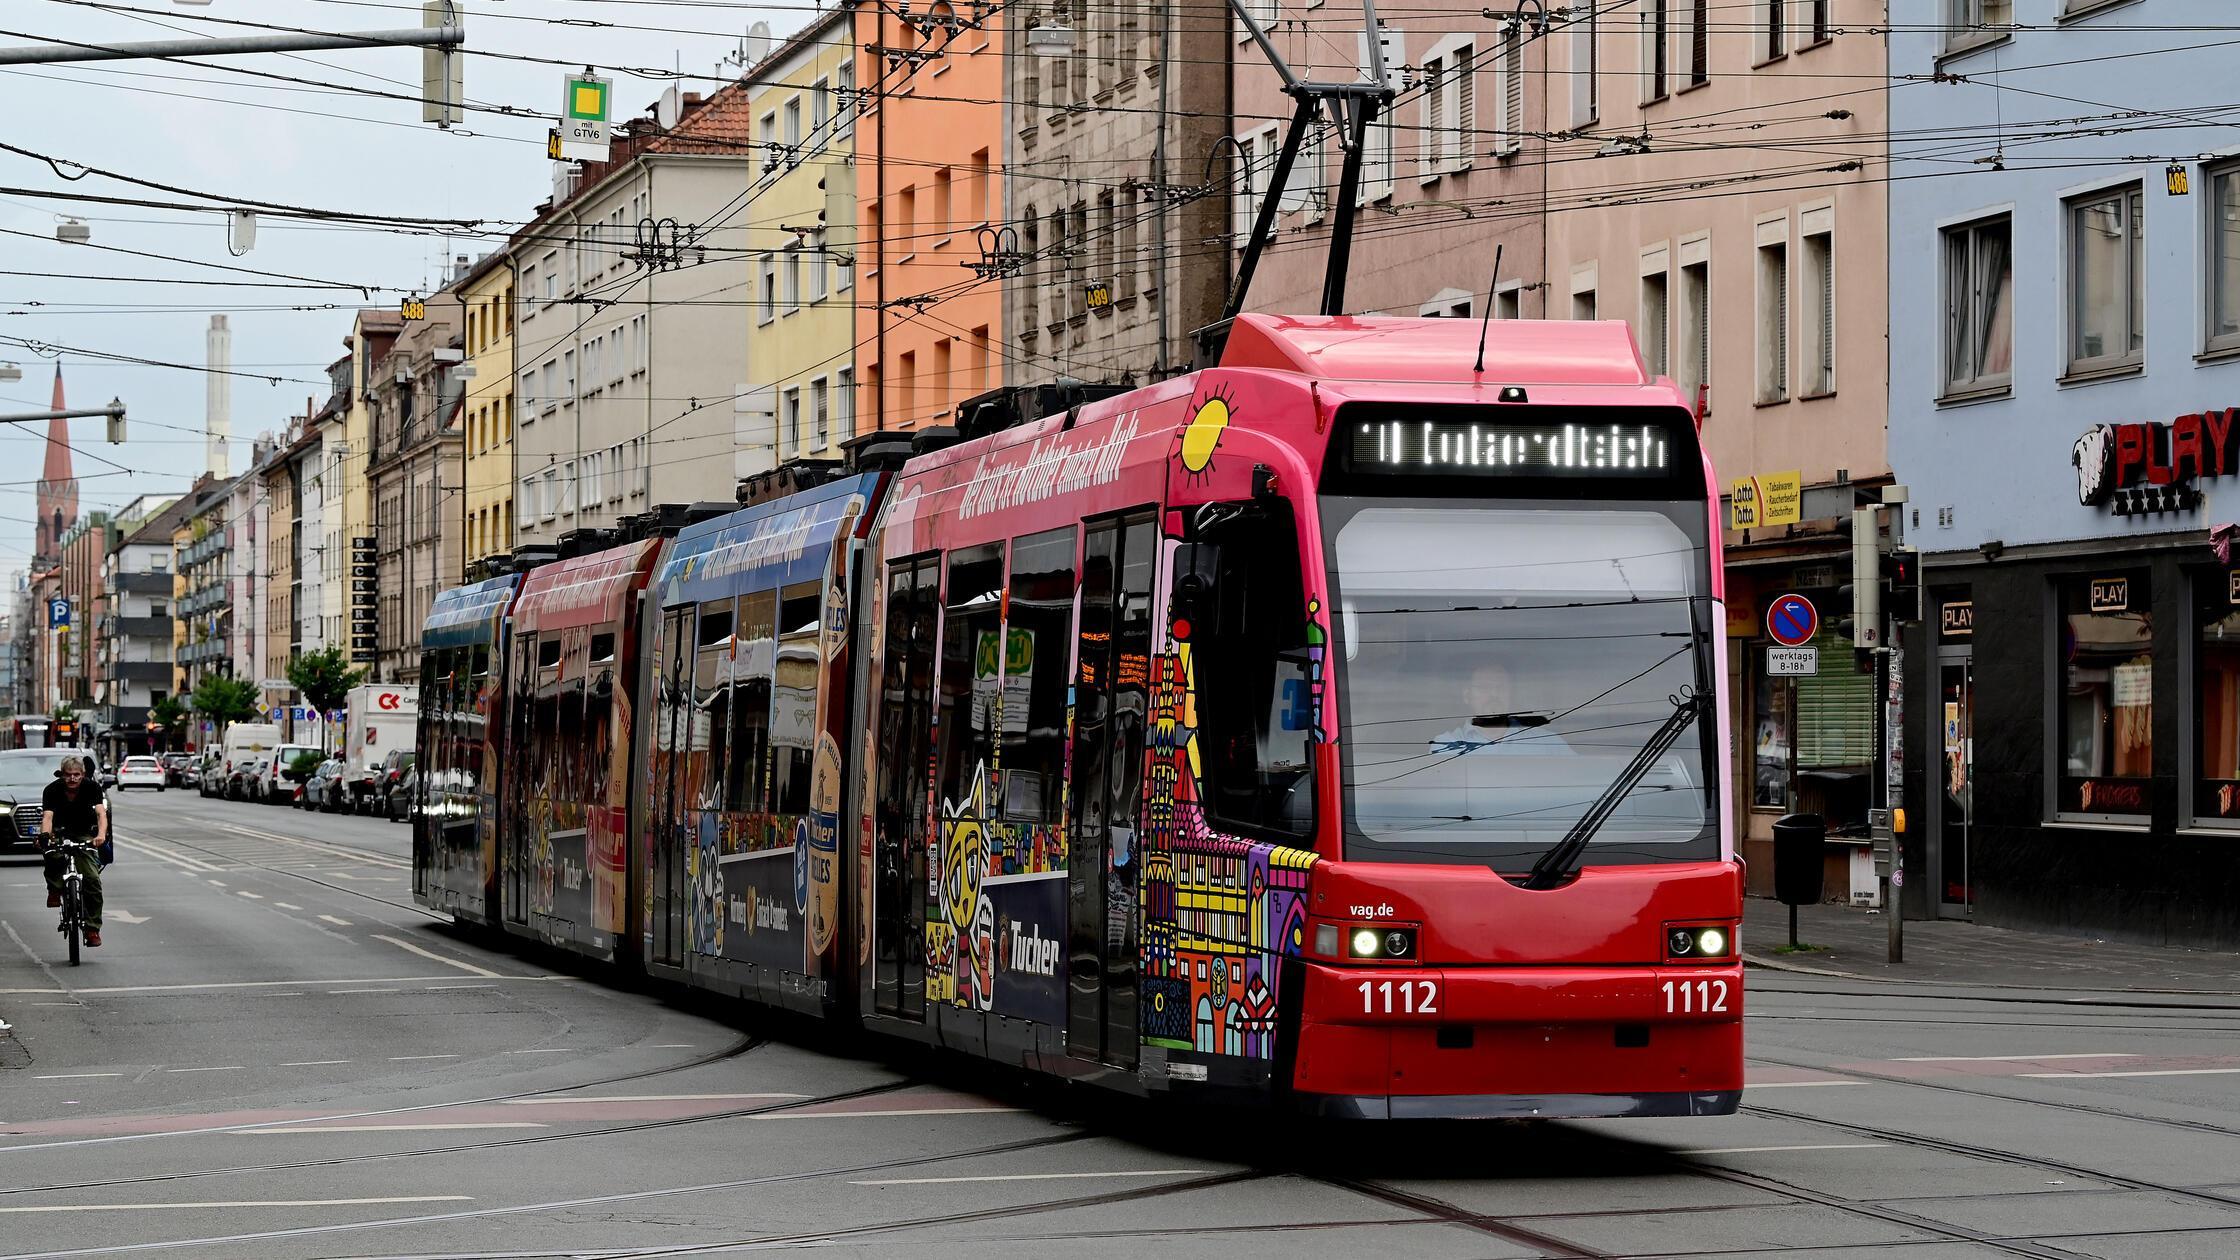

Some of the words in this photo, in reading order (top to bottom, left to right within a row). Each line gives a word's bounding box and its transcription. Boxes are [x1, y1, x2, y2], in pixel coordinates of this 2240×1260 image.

[574, 129, 600, 139] GTV6
[2168, 171, 2188, 193] 486
[1087, 288, 1108, 306] 489
[402, 302, 424, 319] 488
[2115, 407, 2235, 488] PLAY
[1733, 483, 1753, 503] Lotto
[1769, 482, 1793, 492] Tabakwaren
[1769, 491, 1798, 504] Raucherbedarf
[1769, 505, 1794, 517] Zeitschriften
[354, 538, 365, 647] BÄCKEREI
[2093, 585, 2125, 603] PLAY
[54, 605, 67, 621] P
[1771, 651, 1813, 662] werktags
[1350, 902, 1394, 919] vag.de
[1011, 920, 1059, 976] Tucher
[1358, 981, 1437, 1013] 1112
[1661, 980, 1728, 1013] 1112
